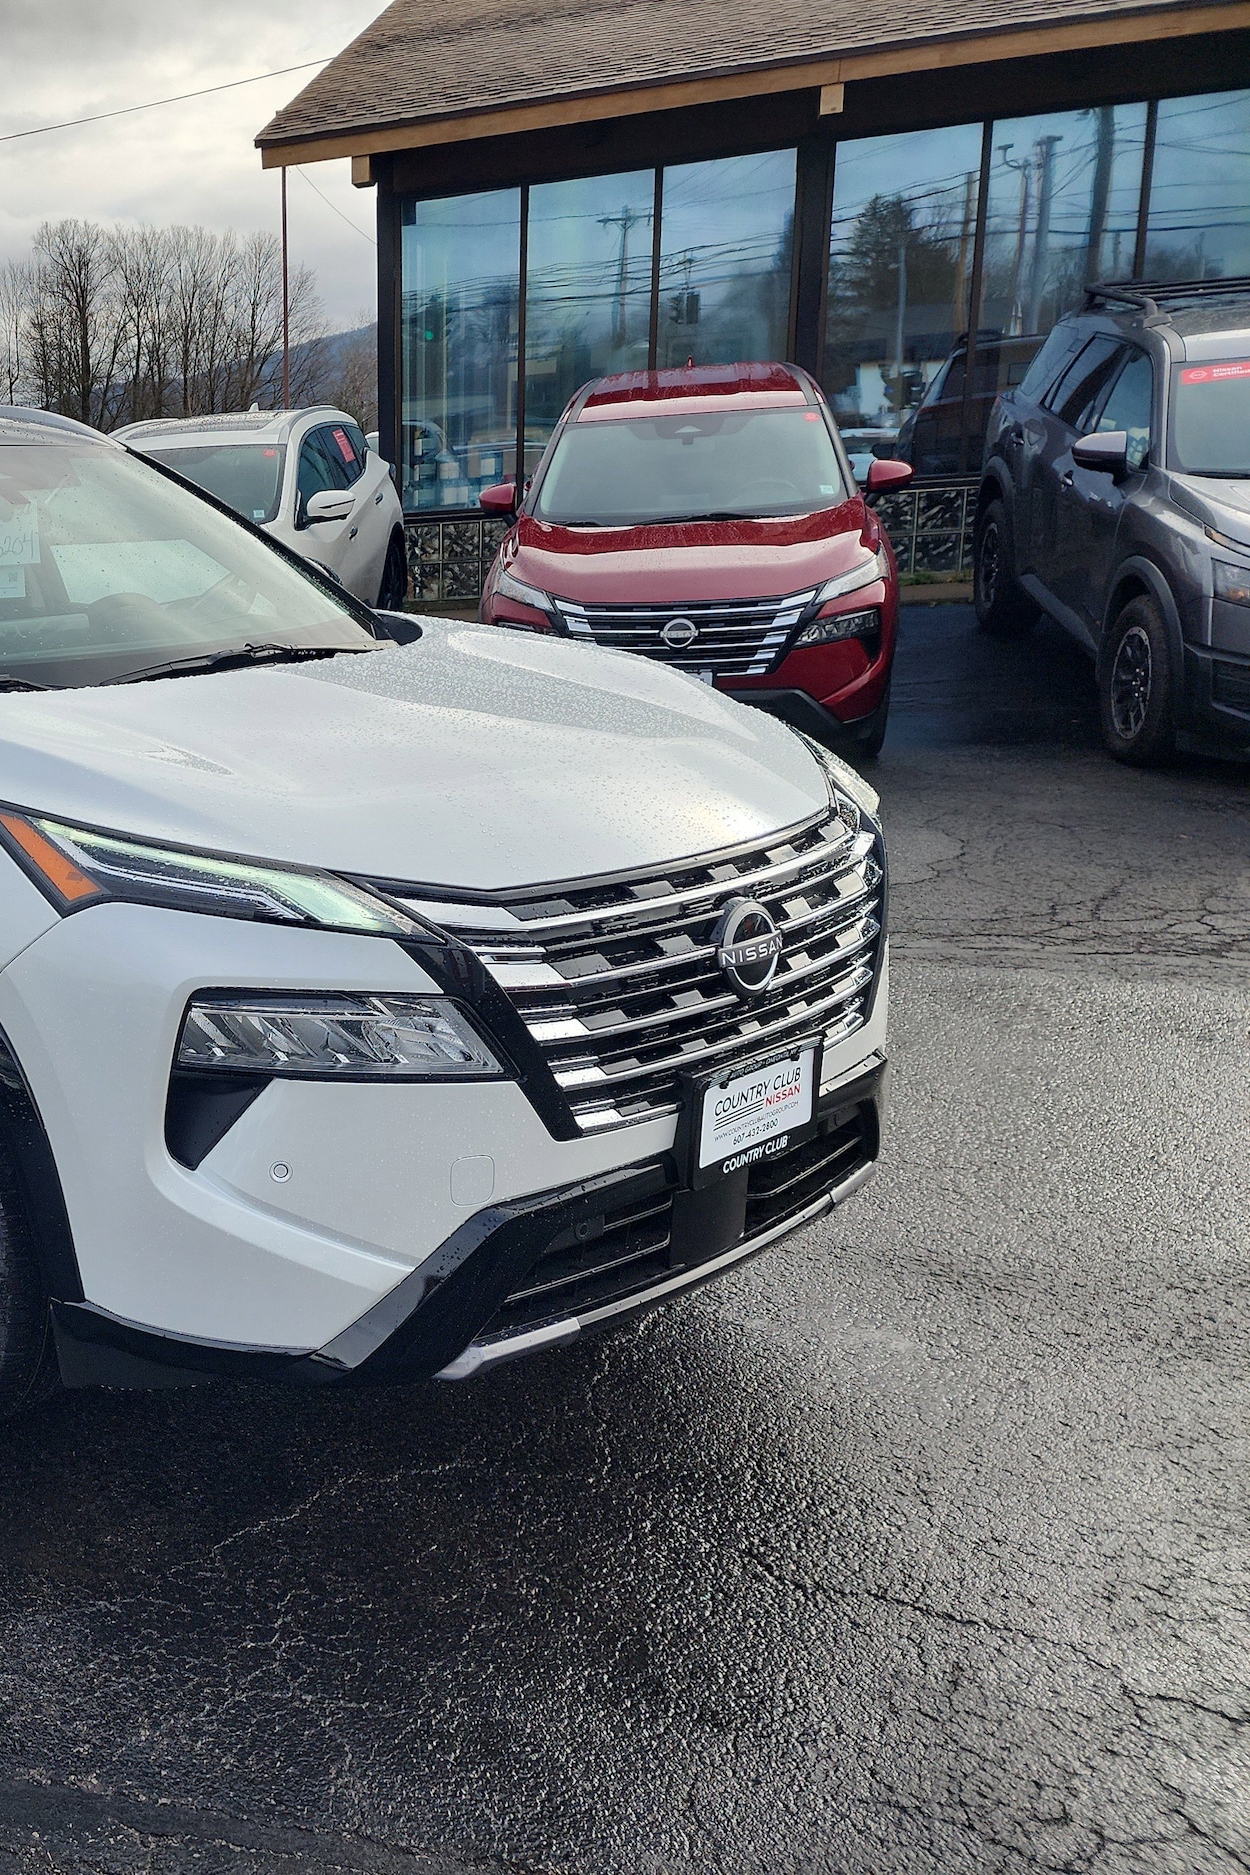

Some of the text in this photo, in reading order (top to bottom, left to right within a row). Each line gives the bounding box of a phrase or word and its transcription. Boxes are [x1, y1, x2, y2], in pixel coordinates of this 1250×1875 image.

[660, 630, 698, 638] NISSAN
[721, 938, 783, 965] NISSAN
[714, 1067, 801, 1117] COUNTRY CLUB
[765, 1083, 801, 1107] NISSAN
[732, 1118, 779, 1145] 607-432-2800
[722, 1135, 789, 1174] COUNTRY CLUB
